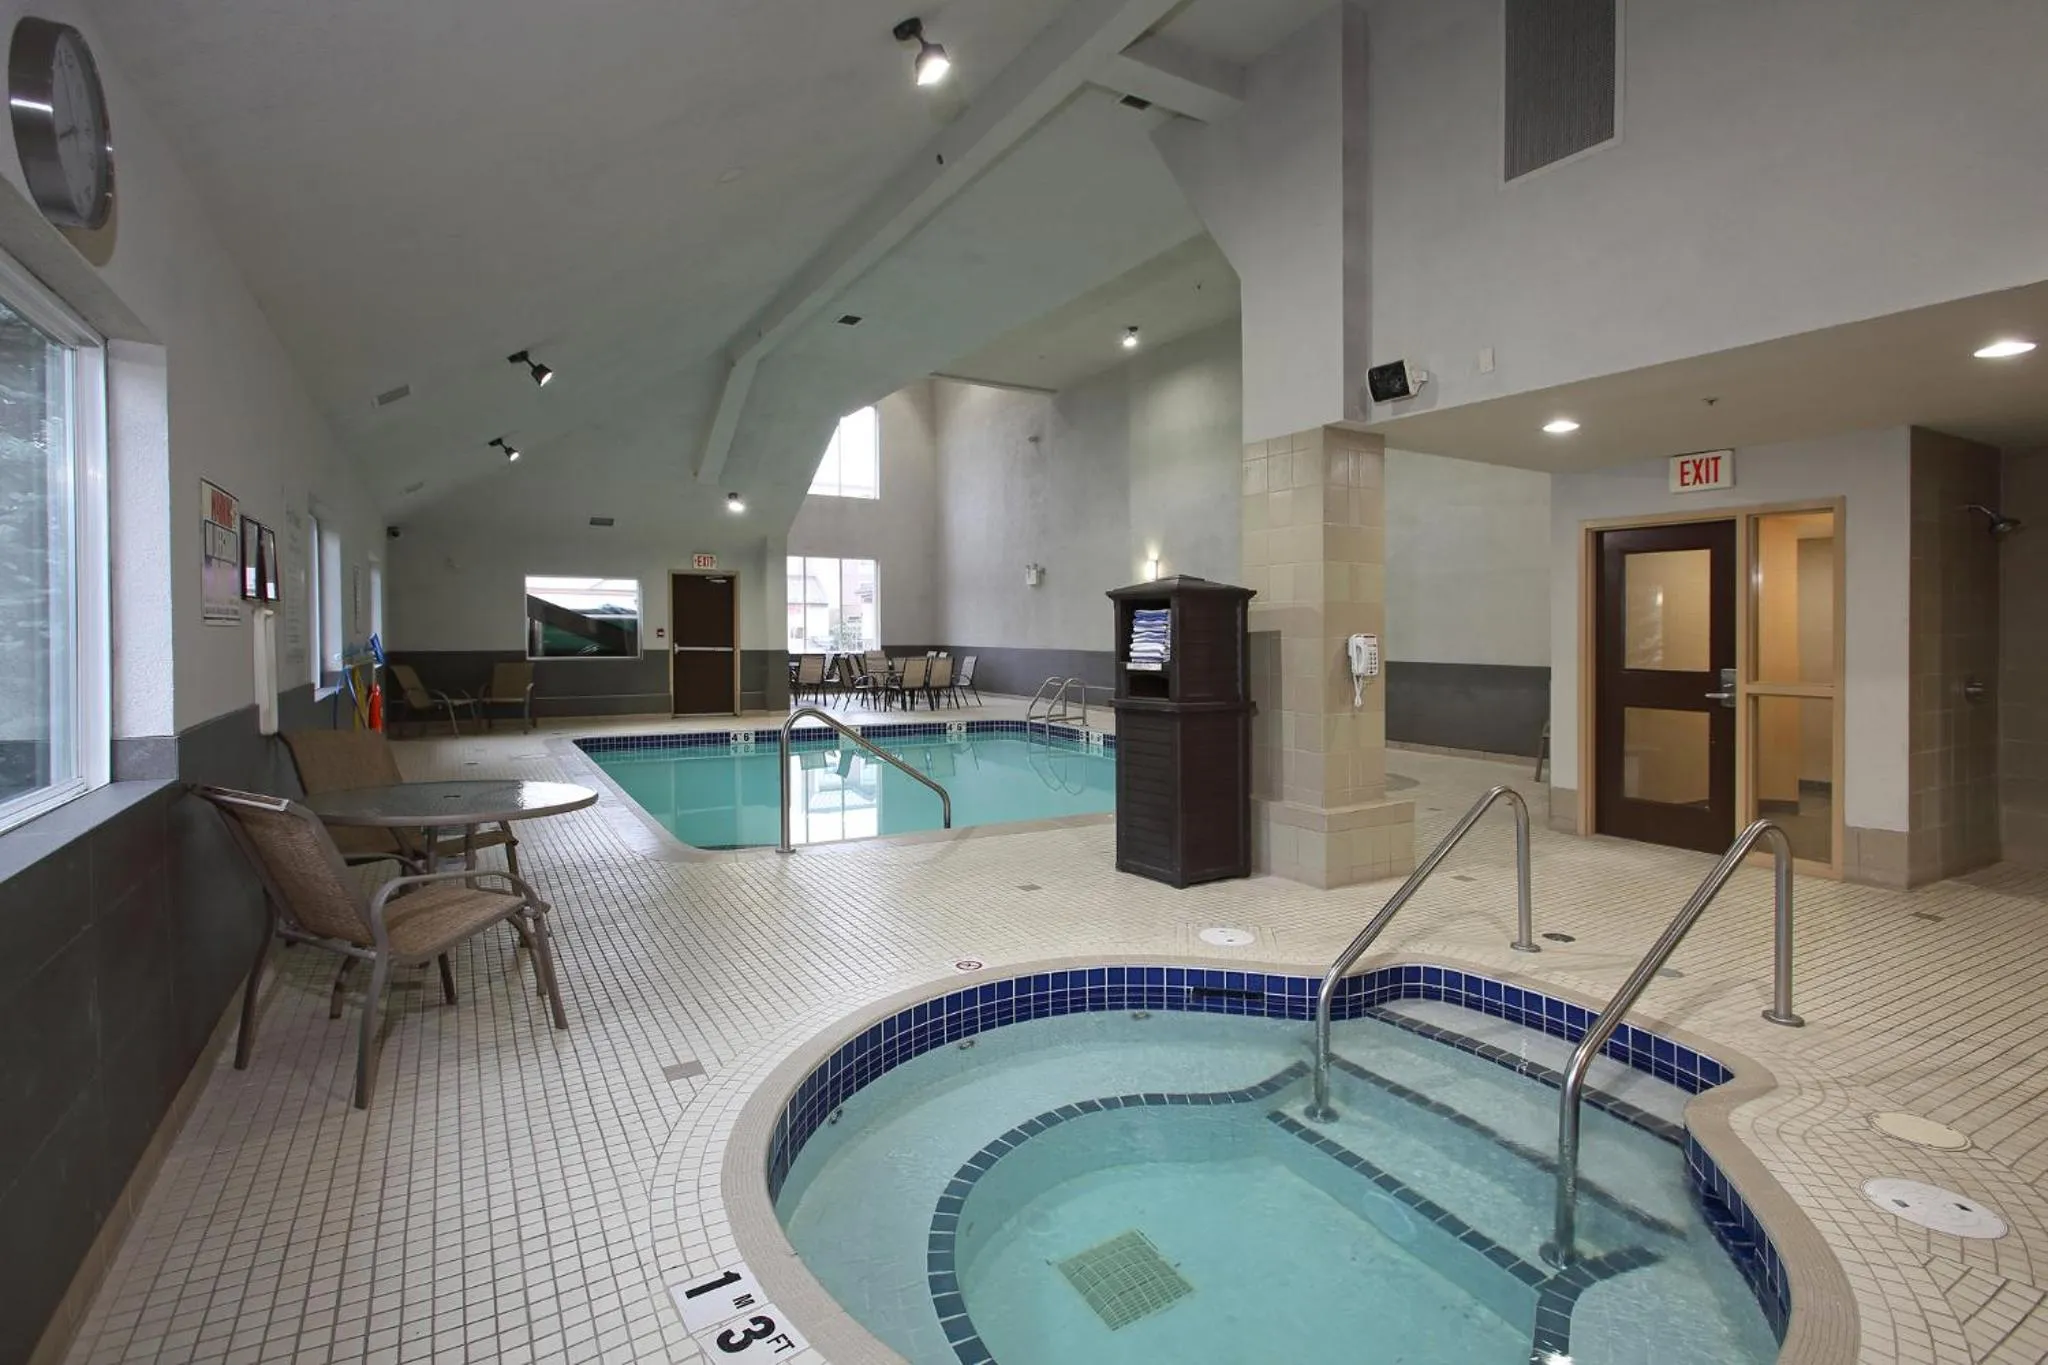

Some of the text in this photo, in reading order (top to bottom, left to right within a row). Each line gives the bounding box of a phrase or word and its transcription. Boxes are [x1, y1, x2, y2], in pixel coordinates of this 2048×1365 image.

[1680, 456, 1722, 486] EXIT
[696, 555, 714, 567] EXIT
[685, 1270, 756, 1310] 1 M
[716, 1315, 796, 1354] 3 FT
